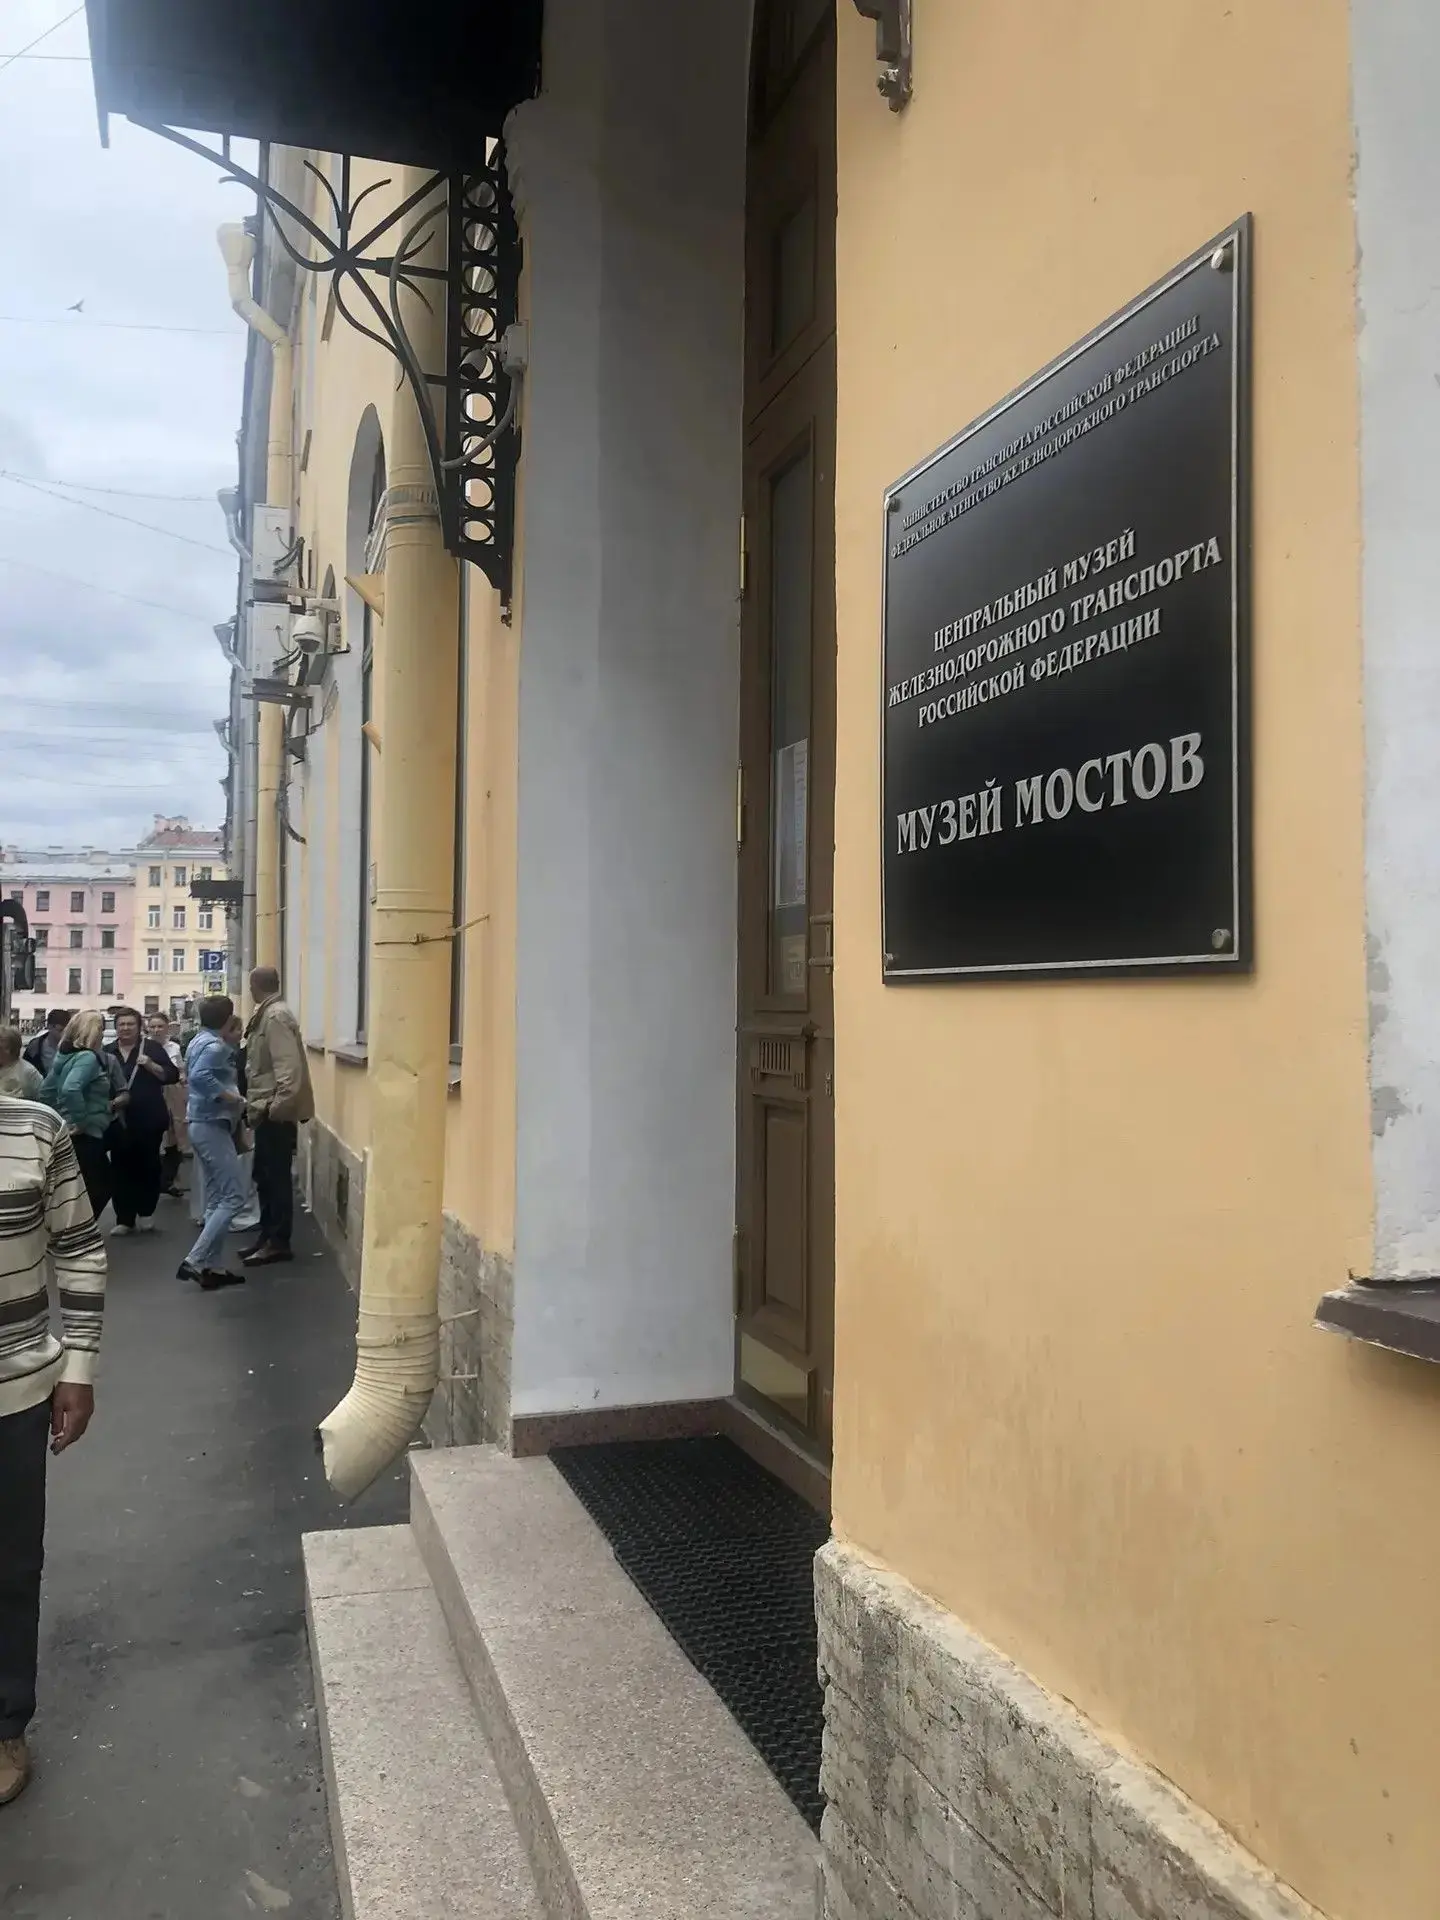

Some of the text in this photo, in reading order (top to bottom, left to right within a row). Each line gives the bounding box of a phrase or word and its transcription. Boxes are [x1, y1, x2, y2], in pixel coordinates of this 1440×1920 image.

[890, 332, 1222, 559] ФЕДЕРАЛЬНОЕ АГЕНТСТВО ЖЕЛЕЗНОДОРОЖНОГО ТРАНСПОРТА
[902, 314, 1199, 531] МИНИСТЕРСТВО ТРАНСПОРТА РОССИЙСКОЙ ФЕДЕРАЦИИ
[888, 536, 1223, 708] ЖЕЛЕЗНОДОРОЖНОГО ТРАНСПОРТА
[934, 527, 1137, 653] ЦЕНТРАЛЬНЫЙ МУЗЕЙ
[918, 607, 1162, 728] РОССИЙСКОЙ ФЕДЕРАЦИИ
[896, 777, 1003, 855] МУЗЕЙ
[1015, 731, 1205, 828] МОСТОВ
[207, 953, 220, 969] P
